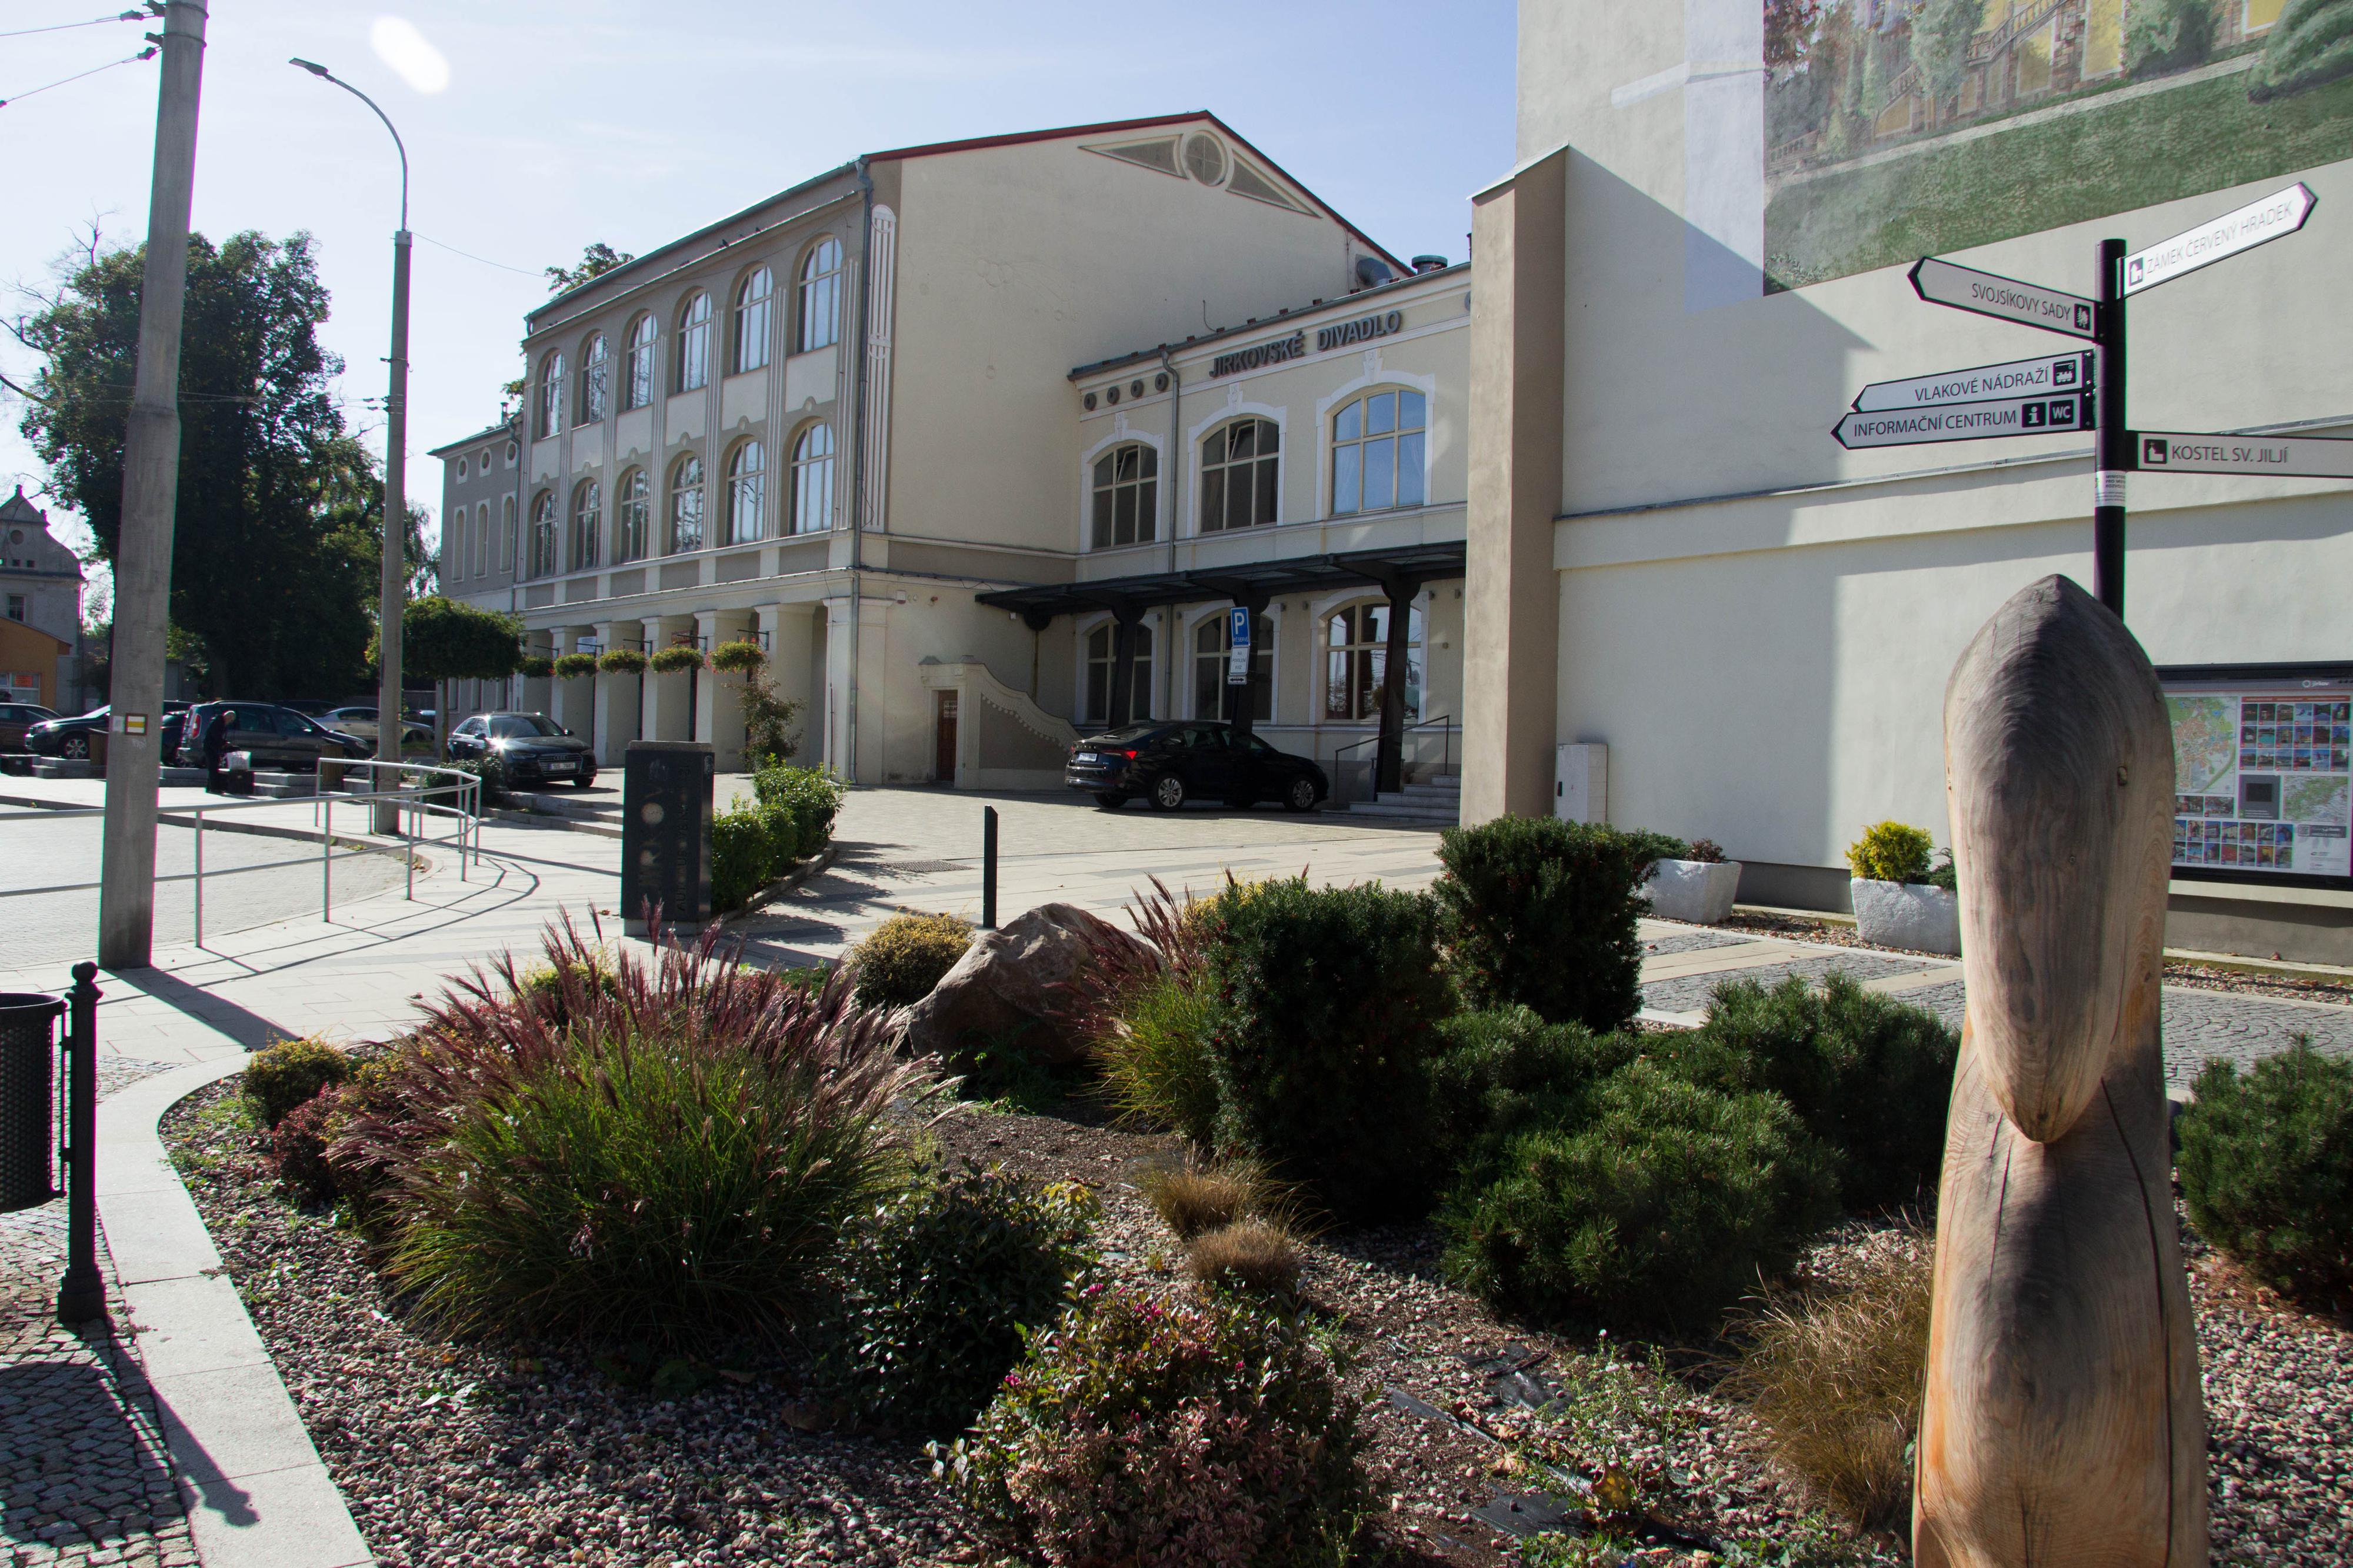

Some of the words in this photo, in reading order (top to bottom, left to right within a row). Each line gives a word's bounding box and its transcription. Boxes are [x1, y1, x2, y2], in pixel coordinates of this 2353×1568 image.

[2147, 245, 2184, 273] ZÁMEK
[2185, 223, 2238, 257] ČERVENÝ
[1972, 283, 2039, 313] SVOJSÍKOVY
[2042, 301, 2071, 321] SADY
[1209, 329, 1305, 377] JIRKOVSKÉ
[1317, 310, 1401, 351] DIVADLO
[1914, 378, 1978, 402] VLAKOVÉ
[1982, 366, 2048, 392] NÁDRAŽÍ
[1854, 414, 1942, 437] INFORMAČNÍ
[1945, 410, 2017, 430] CENTRUM
[2052, 405, 2072, 419] WC
[2172, 445, 2228, 461] KOSTEL
[2232, 448, 2253, 462] SV.
[2257, 446, 2288, 463] JILJÍ
[1234, 612, 1245, 635] P
